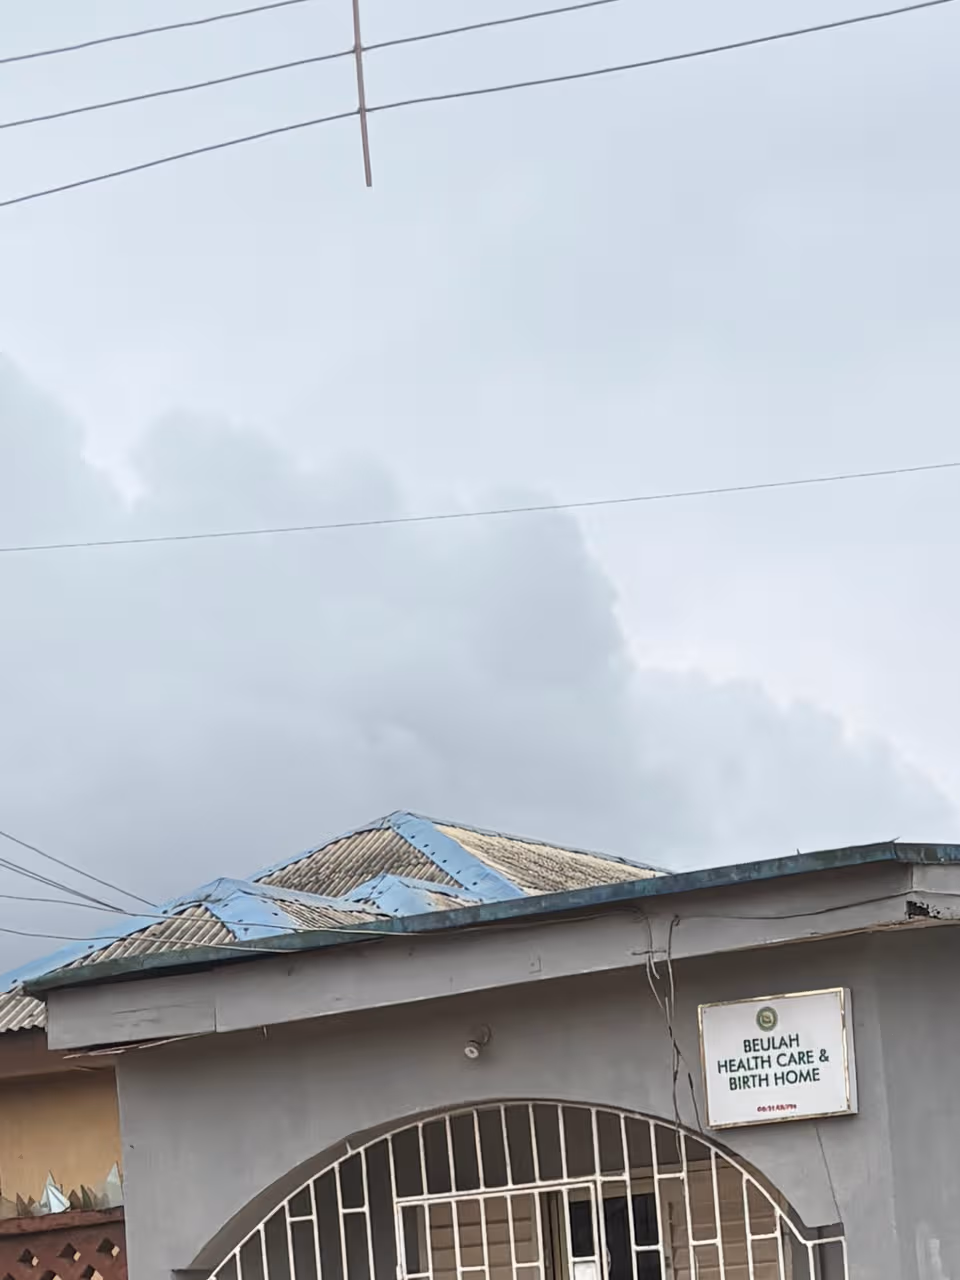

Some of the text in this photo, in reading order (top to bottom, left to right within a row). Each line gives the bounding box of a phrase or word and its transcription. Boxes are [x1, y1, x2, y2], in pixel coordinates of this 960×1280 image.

[743, 1033, 799, 1053] BEULAH
[717, 1049, 829, 1074] HEALTH CARE &
[729, 1068, 820, 1091] BIRTH HOME
